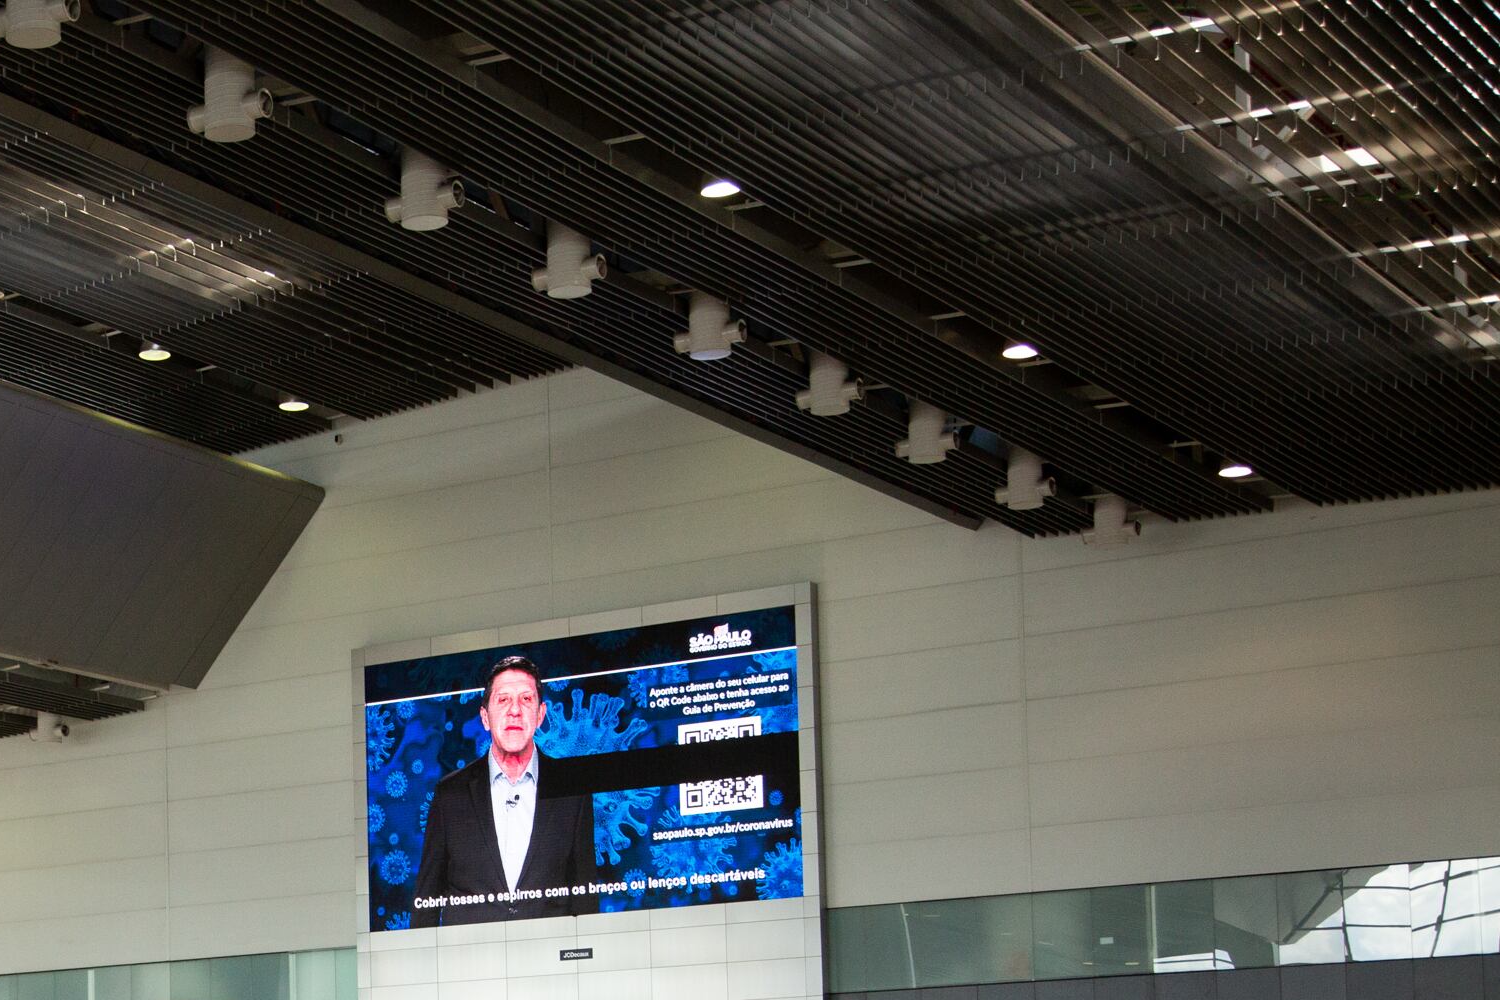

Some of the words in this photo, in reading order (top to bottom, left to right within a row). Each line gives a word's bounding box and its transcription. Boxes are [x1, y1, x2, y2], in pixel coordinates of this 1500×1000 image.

[689, 632, 714, 648] SÃO
[714, 629, 752, 645] PAULO
[650, 686, 678, 698] Aponte
[686, 681, 714, 692] câmera
[715, 680, 726, 690] do
[728, 679, 742, 688] seu
[743, 674, 770, 685] celular
[770, 672, 789, 684] para
[656, 697, 670, 708] QR
[670, 696, 692, 706] Code
[692, 692, 718, 704] abaixo
[726, 688, 750, 699] tenha
[750, 686, 777, 697] acesso
[778, 684, 790, 693] ao
[682, 704, 701, 716] Guia
[702, 702, 713, 712] de
[714, 698, 756, 712] Prevenção
[653, 818, 793, 841] saopaulo.sp.gov.br/coronavirus
[414, 896, 448, 909] Cobrir
[450, 894, 486, 906] tosses
[488, 893, 495, 902] e
[497, 888, 542, 904] espirros
[545, 886, 570, 898] com
[571, 884, 586, 896] os
[588, 881, 627, 896] braços
[630, 880, 646, 890] ou
[648, 876, 687, 890] lenços
[690, 867, 766, 885] descartáveis
